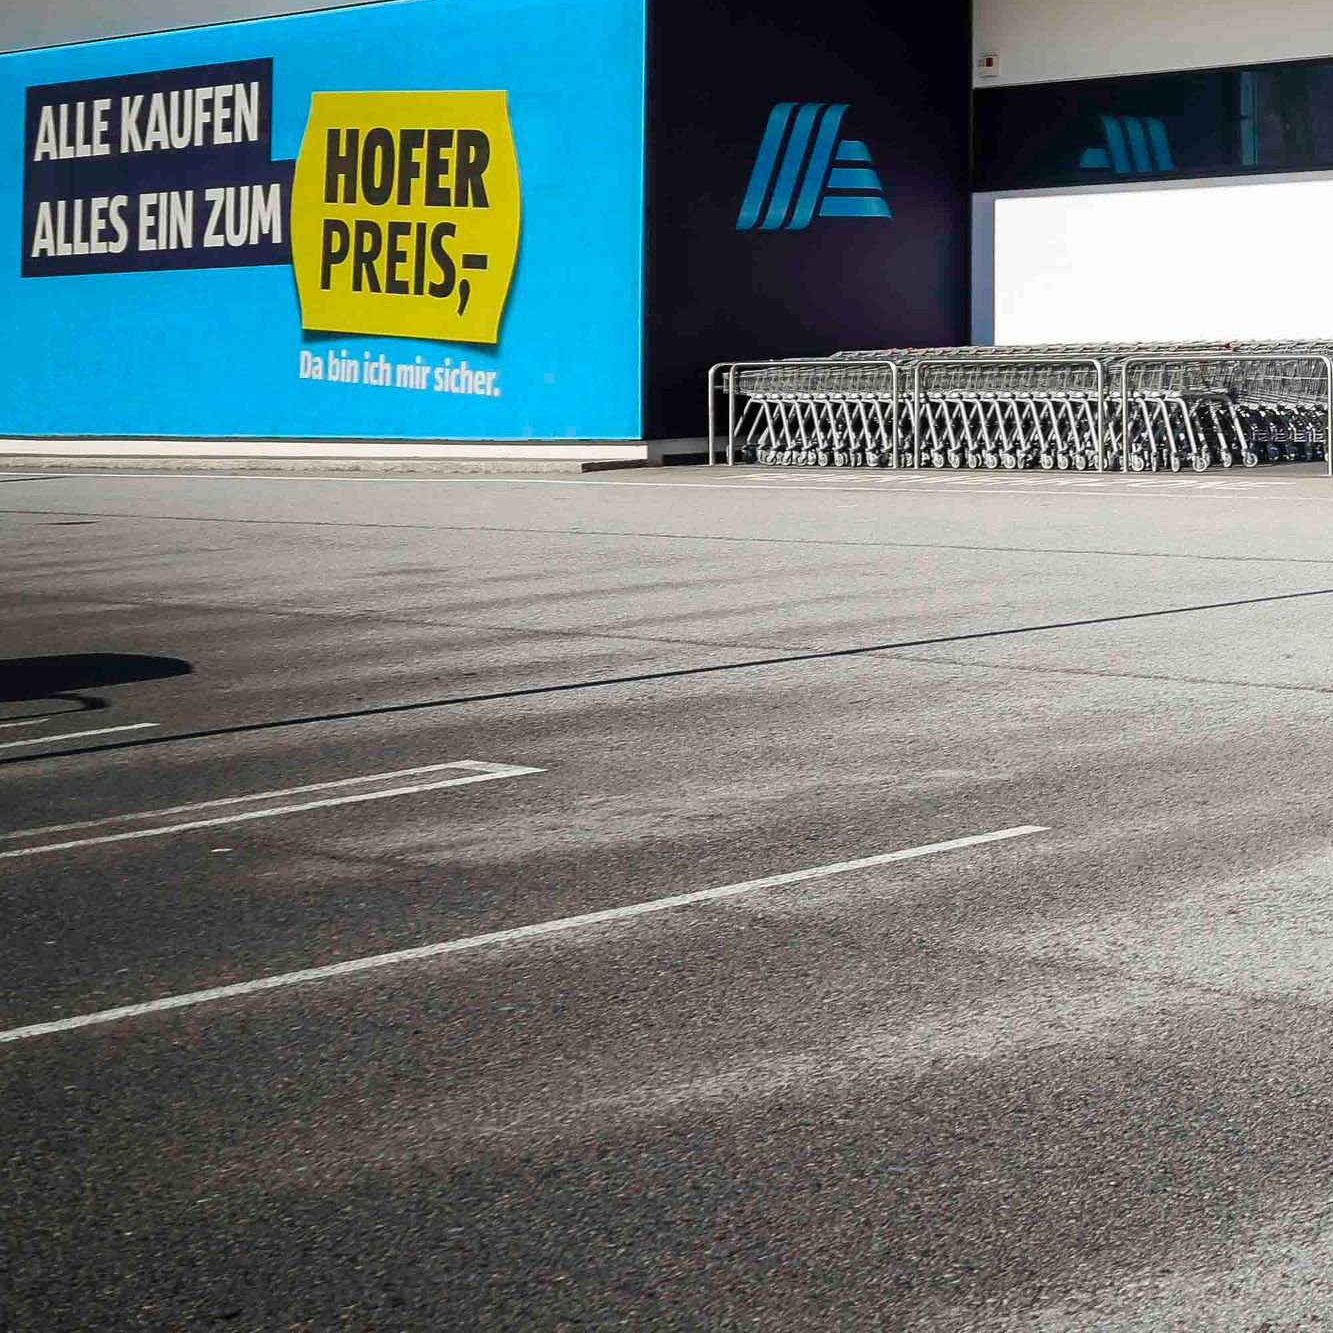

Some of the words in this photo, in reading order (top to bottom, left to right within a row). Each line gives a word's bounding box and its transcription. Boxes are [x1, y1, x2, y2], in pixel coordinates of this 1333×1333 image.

[33, 98, 112, 161] ALLE
[120, 81, 259, 154] KAUFEN
[324, 127, 491, 208] HOFER
[31, 194, 128, 258] ALLES
[138, 190, 194, 252] EIN
[203, 183, 283, 248] ZUM
[320, 218, 489, 317] PREIS,-
[299, 350, 324, 380] Da
[327, 348, 359, 384] bin
[363, 350, 391, 387] ich
[396, 354, 431, 391] mir
[433, 357, 501, 398] sicher.
